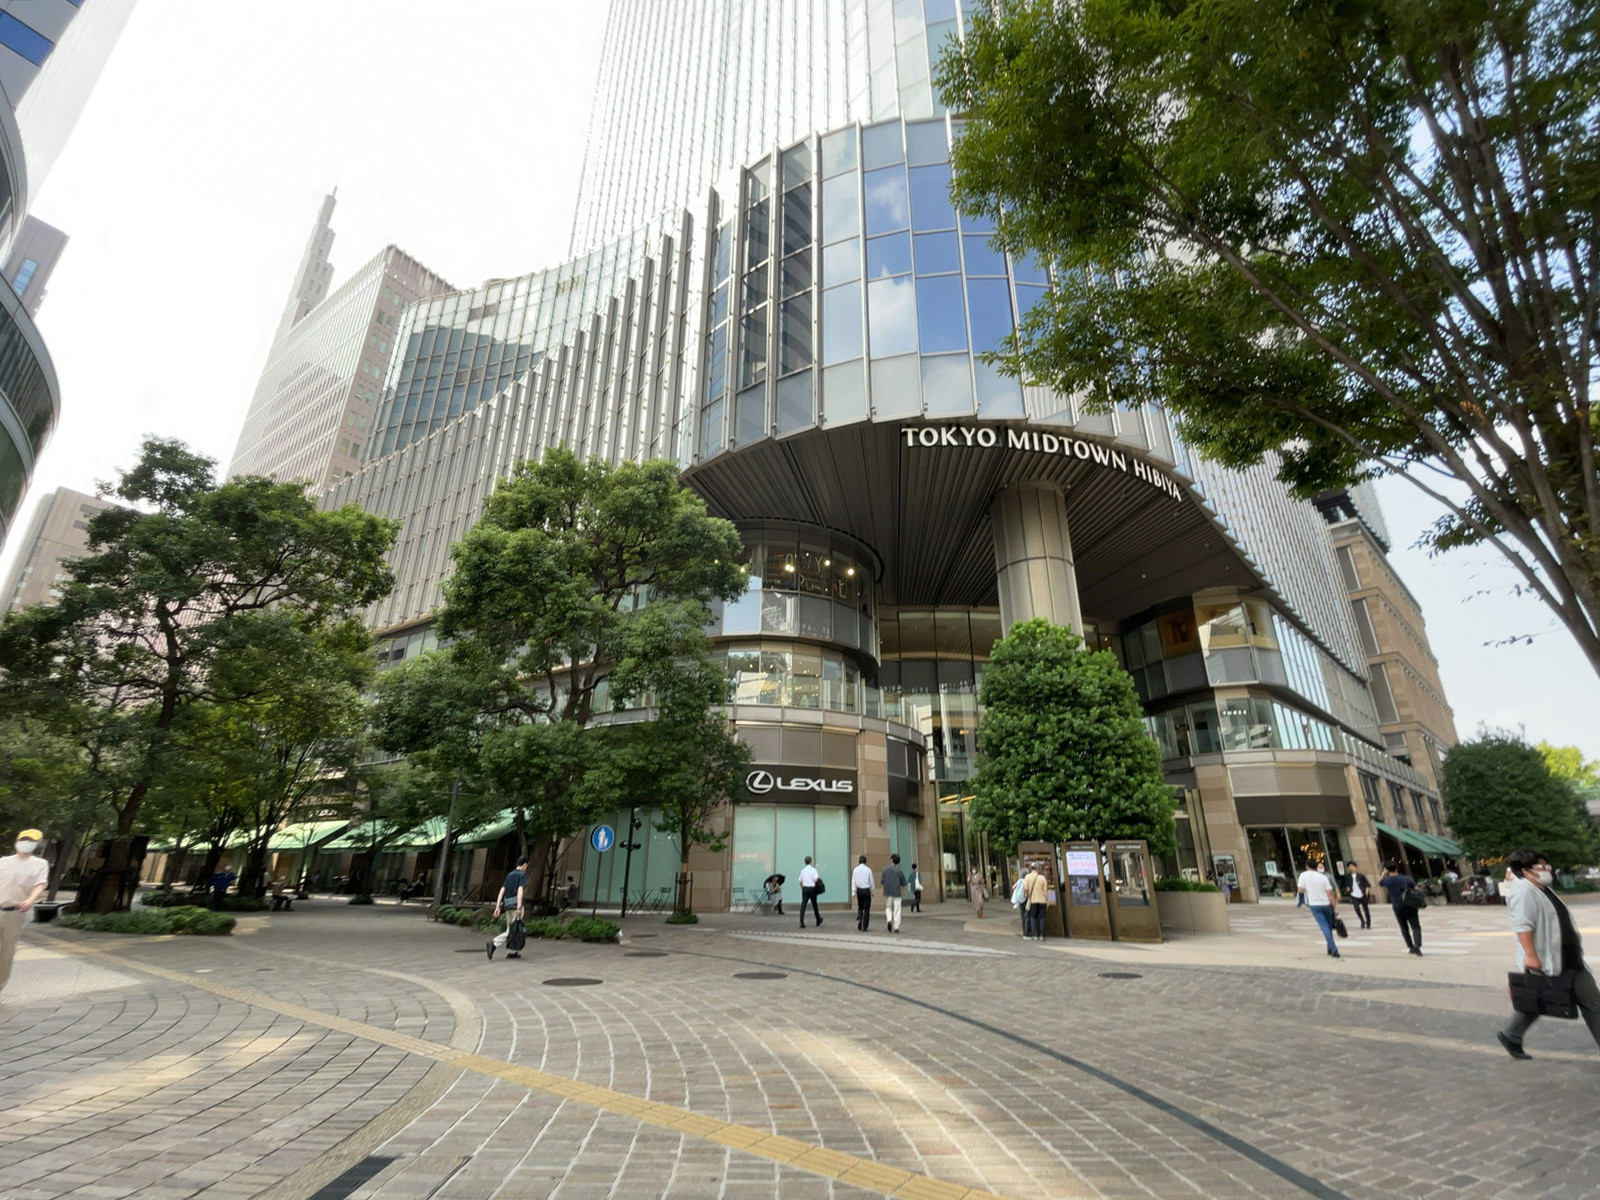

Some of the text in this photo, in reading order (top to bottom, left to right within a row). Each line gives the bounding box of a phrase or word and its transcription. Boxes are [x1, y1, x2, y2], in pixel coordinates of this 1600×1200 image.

[901, 426, 1182, 502] TOKYO MIDTOWN HIBIYA
[776, 777, 853, 793] LEXUS
